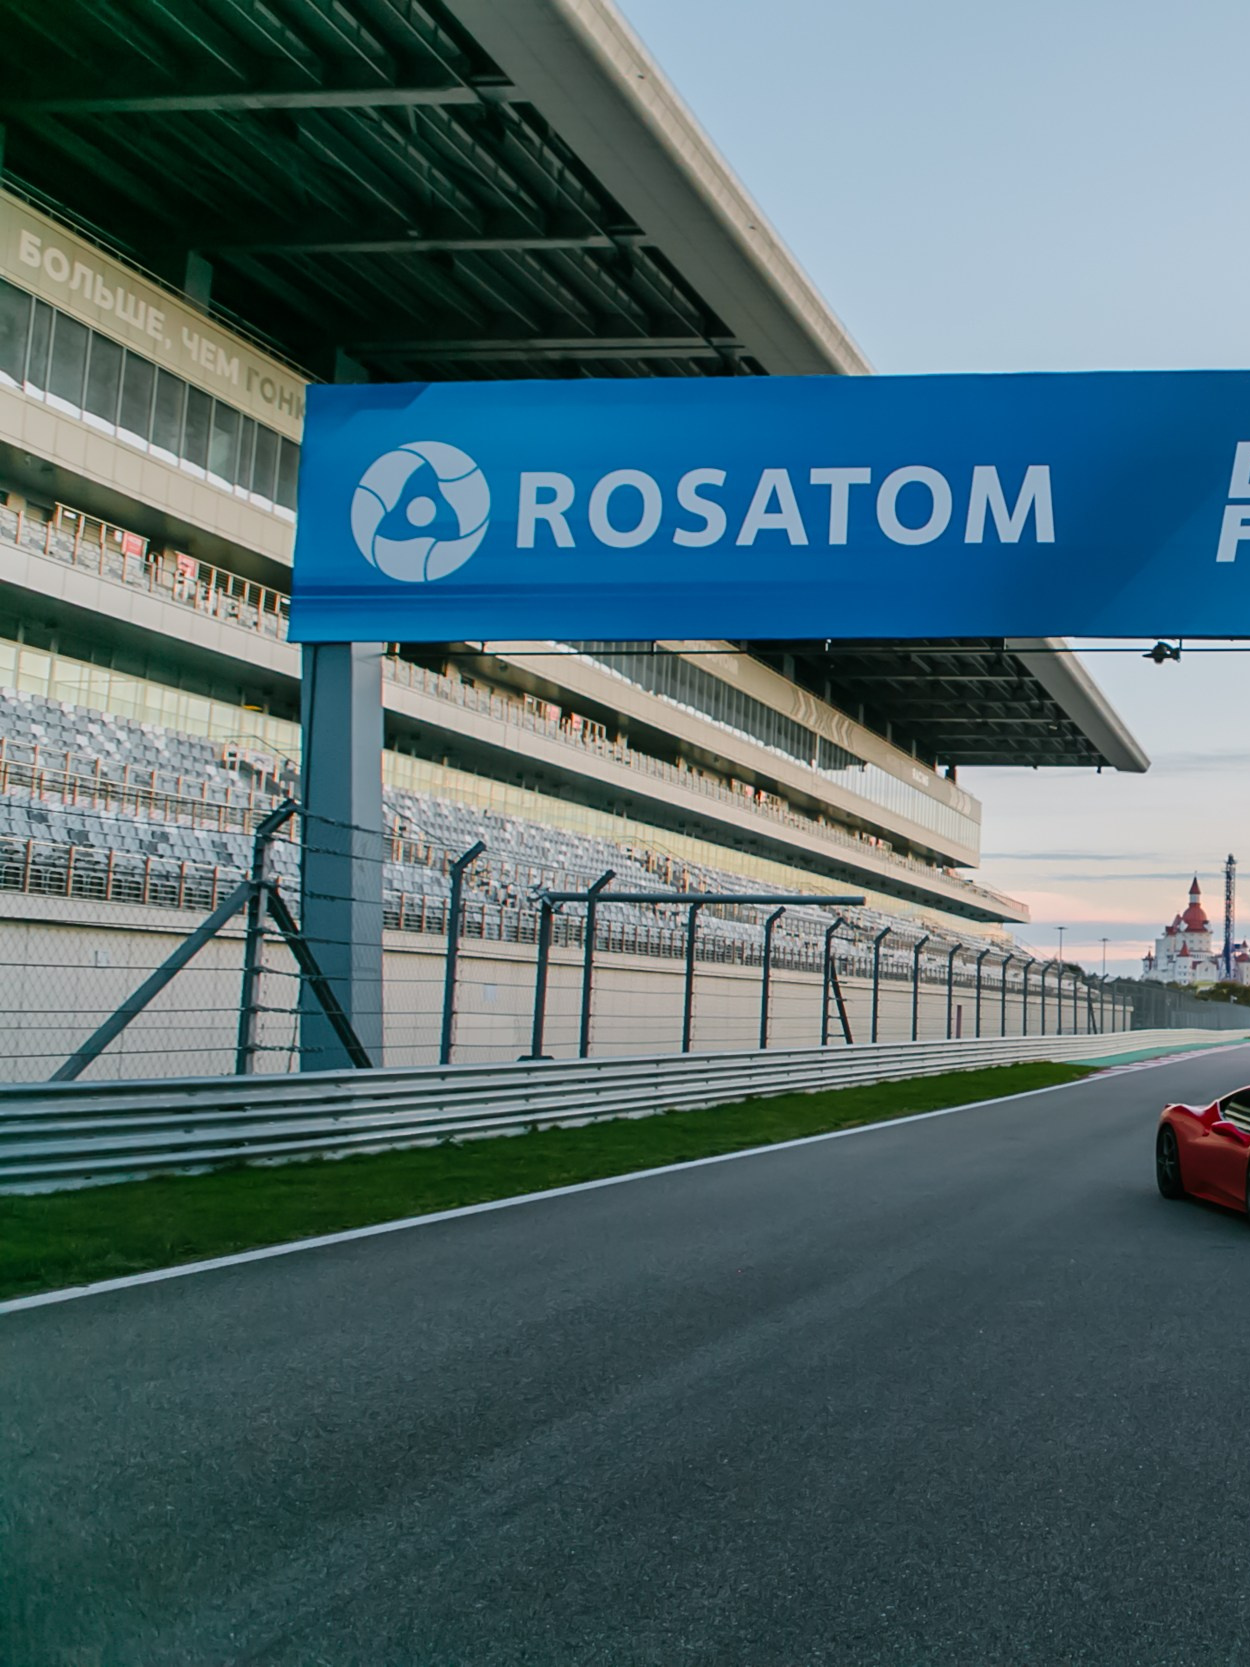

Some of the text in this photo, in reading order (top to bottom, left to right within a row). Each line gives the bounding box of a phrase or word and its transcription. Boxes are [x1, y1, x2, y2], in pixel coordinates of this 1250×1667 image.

[18, 229, 173, 350] БОЛЬШЕ,
[181, 326, 240, 385] ЧЕМ
[517, 465, 1055, 548] ROSATOM
